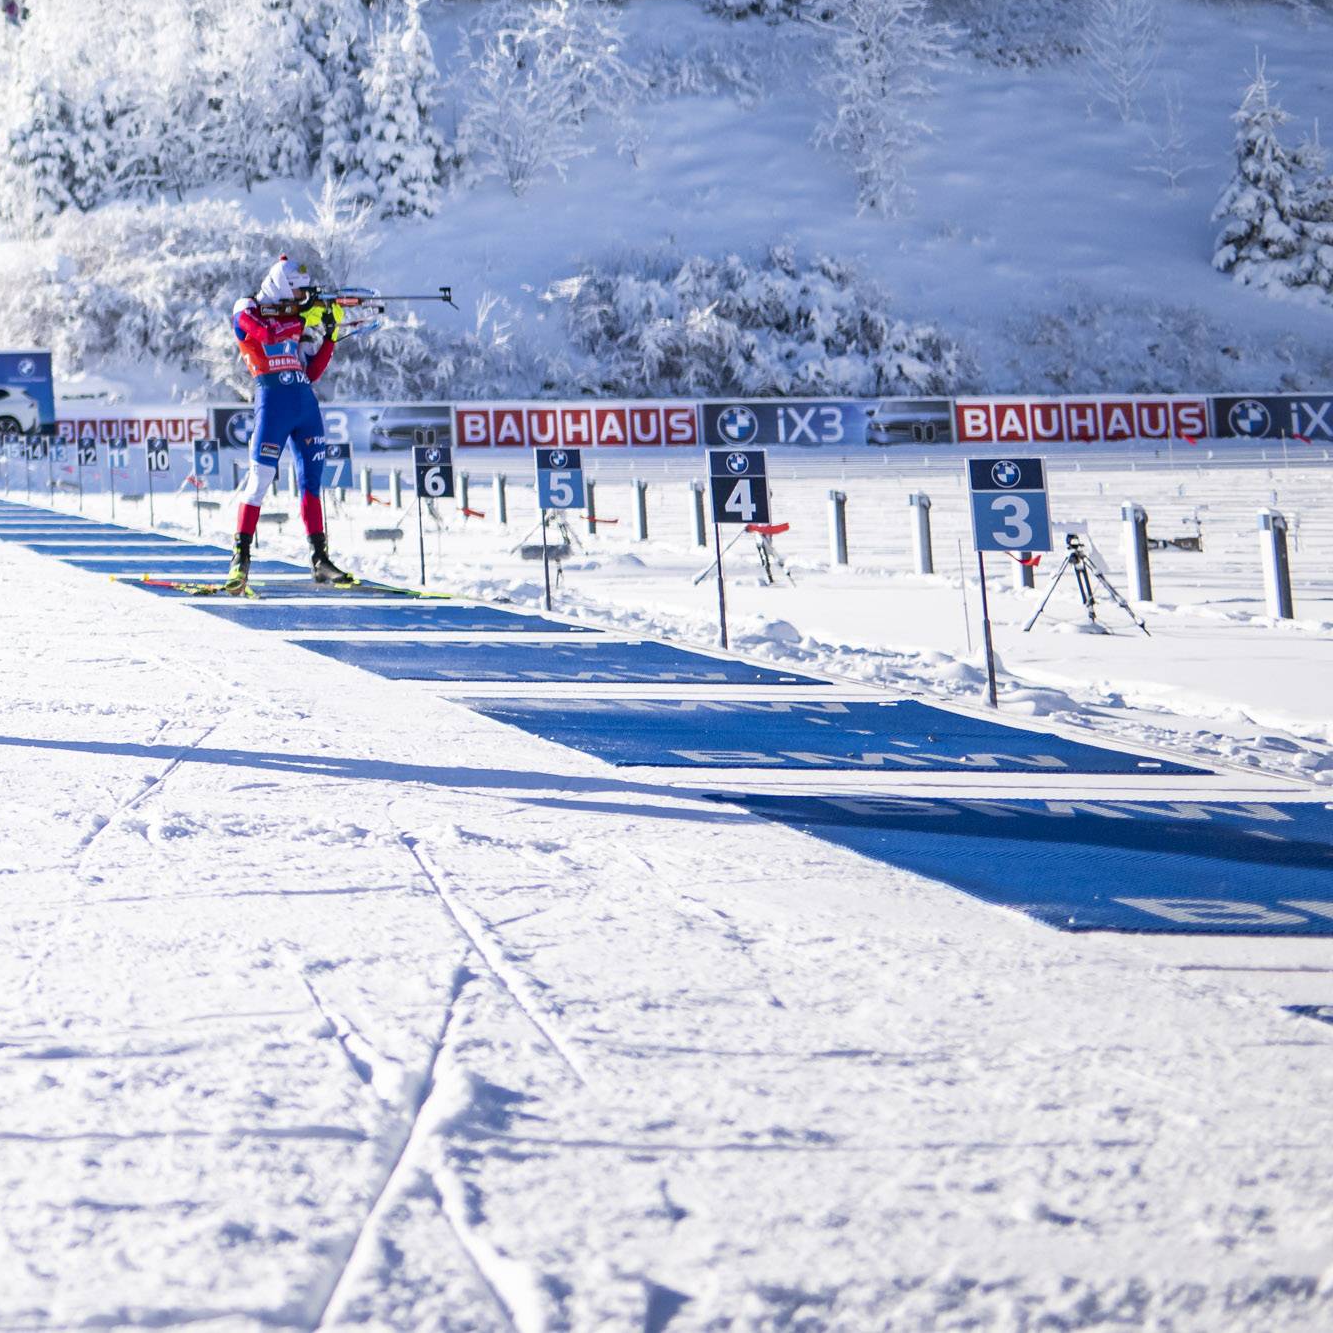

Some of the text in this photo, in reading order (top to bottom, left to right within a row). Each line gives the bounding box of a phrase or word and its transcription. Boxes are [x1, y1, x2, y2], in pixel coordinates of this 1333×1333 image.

[58, 421, 208, 443] BAUHAUS
[464, 410, 694, 443] BAUHAUS
[776, 406, 845, 443] iX3
[963, 406, 1203, 438] BAUHAUS
[78, 449, 97, 465] 12
[110, 449, 129, 467] 11
[148, 452, 169, 470] 10
[200, 453, 214, 475] 9
[326, 458, 344, 488] 7
[424, 466, 446, 496] 6
[549, 471, 574, 507] 5
[724, 478, 757, 521] 4
[990, 494, 1033, 548] 3
